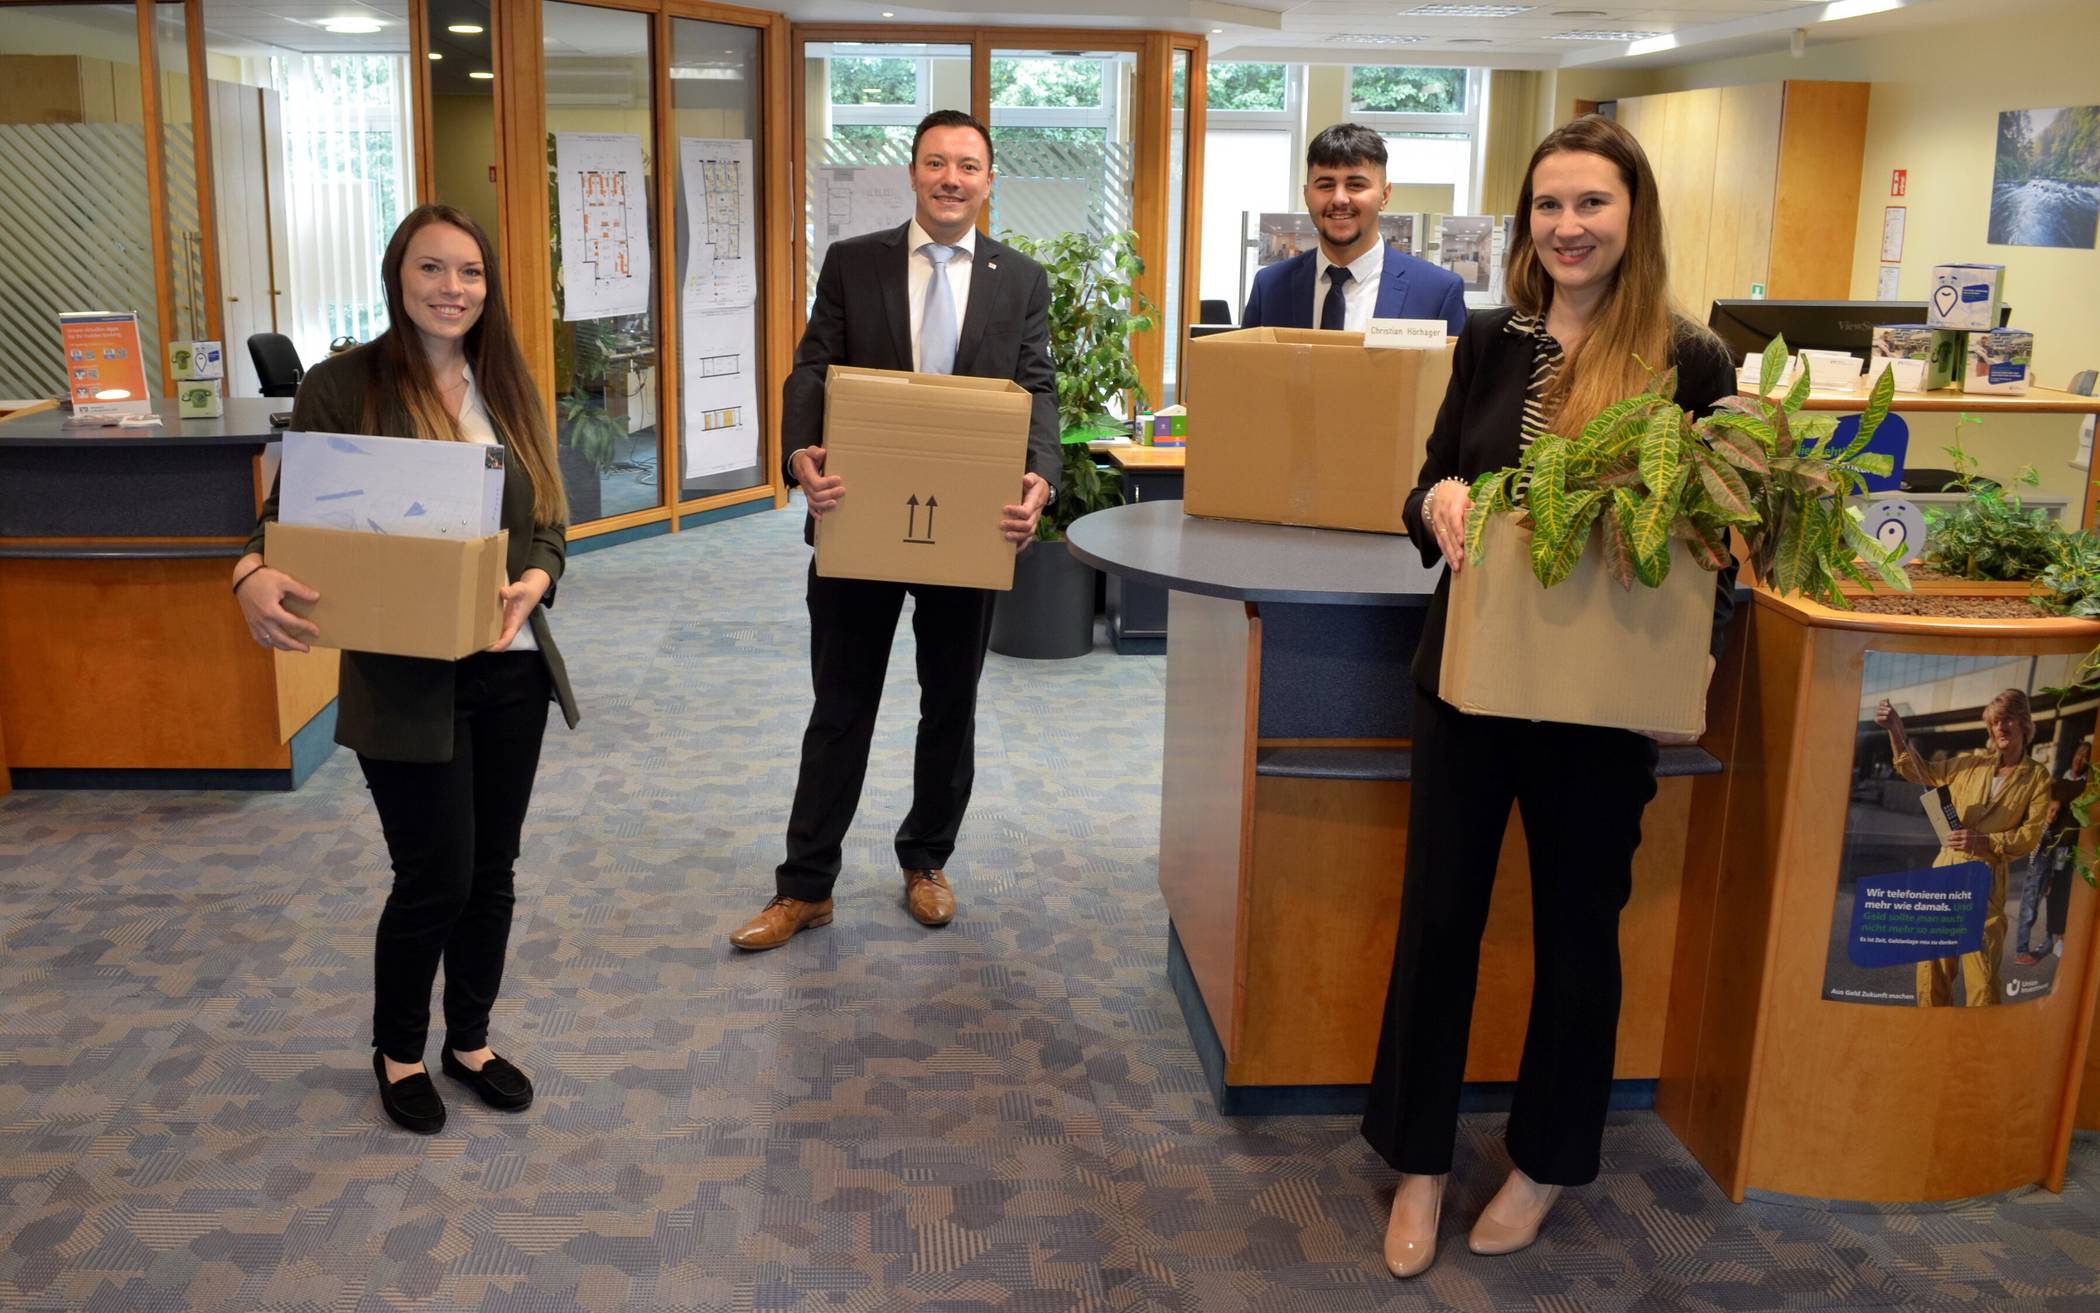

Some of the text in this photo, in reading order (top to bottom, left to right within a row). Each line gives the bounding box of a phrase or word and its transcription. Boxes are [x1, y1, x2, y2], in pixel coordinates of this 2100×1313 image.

[1370, 326, 1441, 338] Christian Hörhager
[1866, 888, 1972, 900] Wir telefonieren nicht
[1864, 900, 1974, 912] mehr wie damals. Und
[1863, 911, 1965, 923] Geld sollte man auch
[1861, 923, 1887, 932] nicht
[1888, 924, 1915, 933] mehr
[1845, 989, 1861, 997] Geld
[1861, 990, 1888, 999] Zukunft
